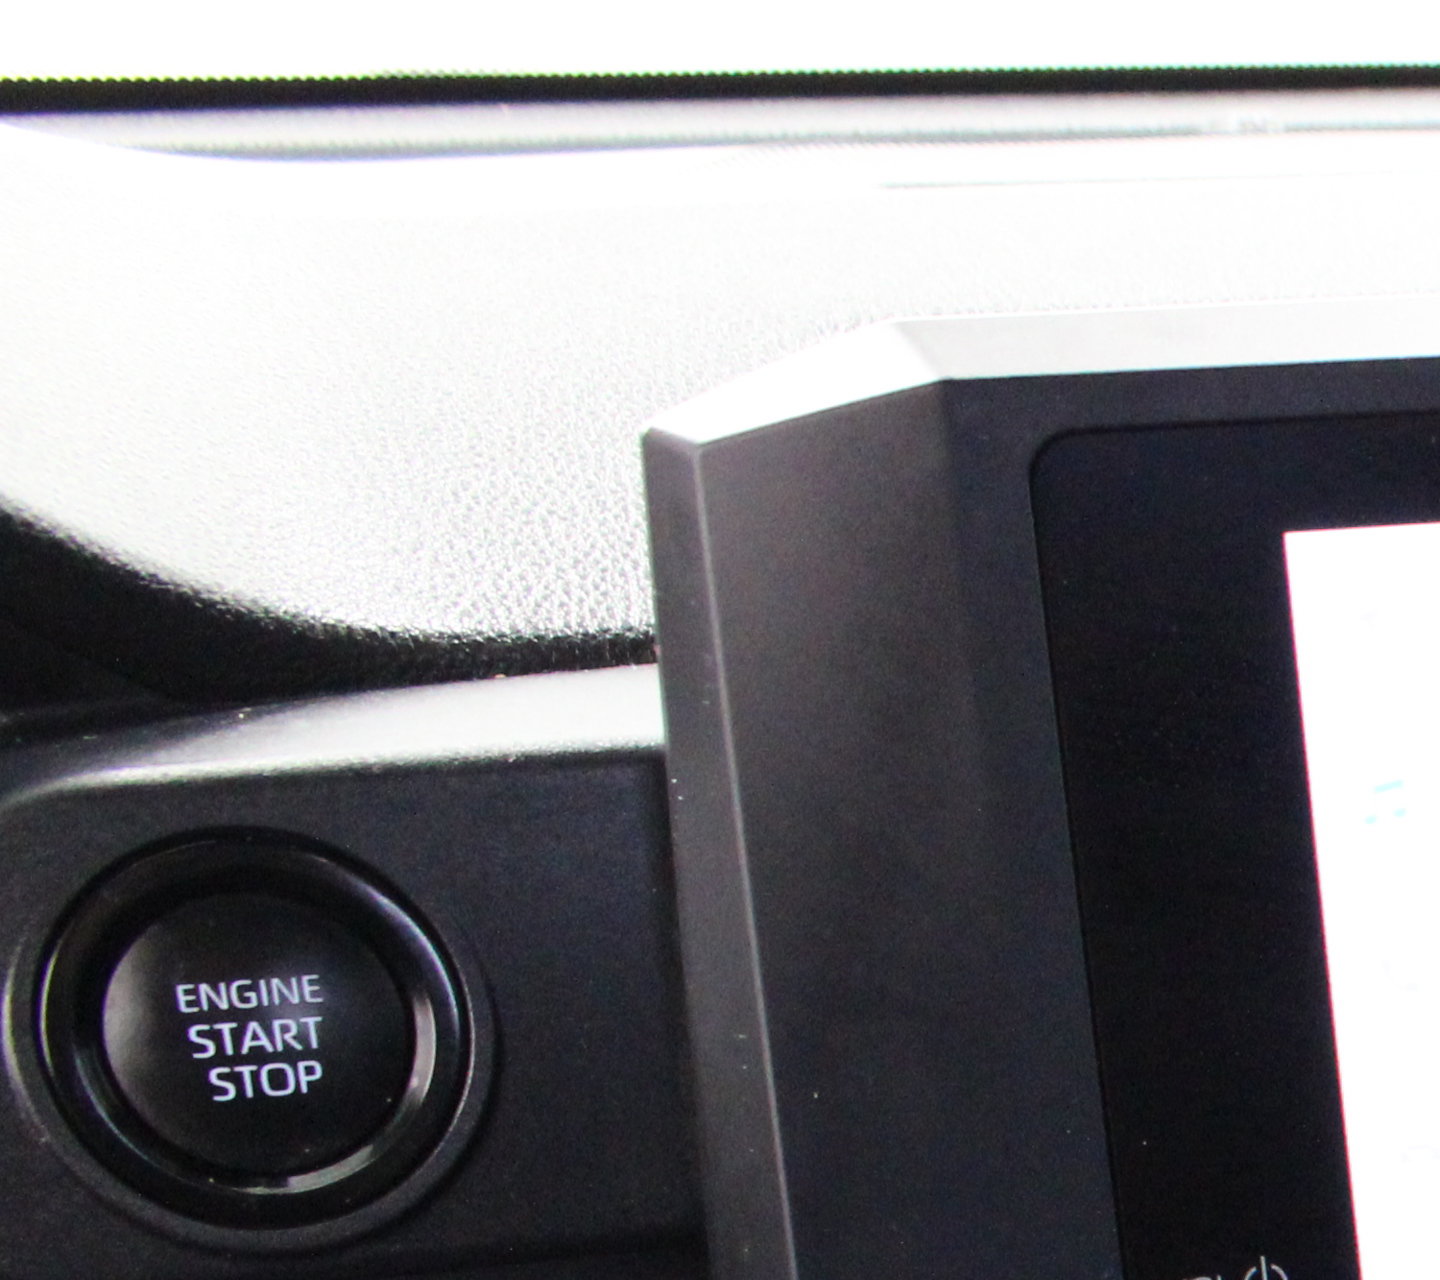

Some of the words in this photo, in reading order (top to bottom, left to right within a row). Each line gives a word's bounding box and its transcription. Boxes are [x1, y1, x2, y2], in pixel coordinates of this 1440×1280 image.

[175, 975, 324, 1014] ENGINE
[188, 1016, 323, 1059] START
[208, 1061, 323, 1101] STOP
